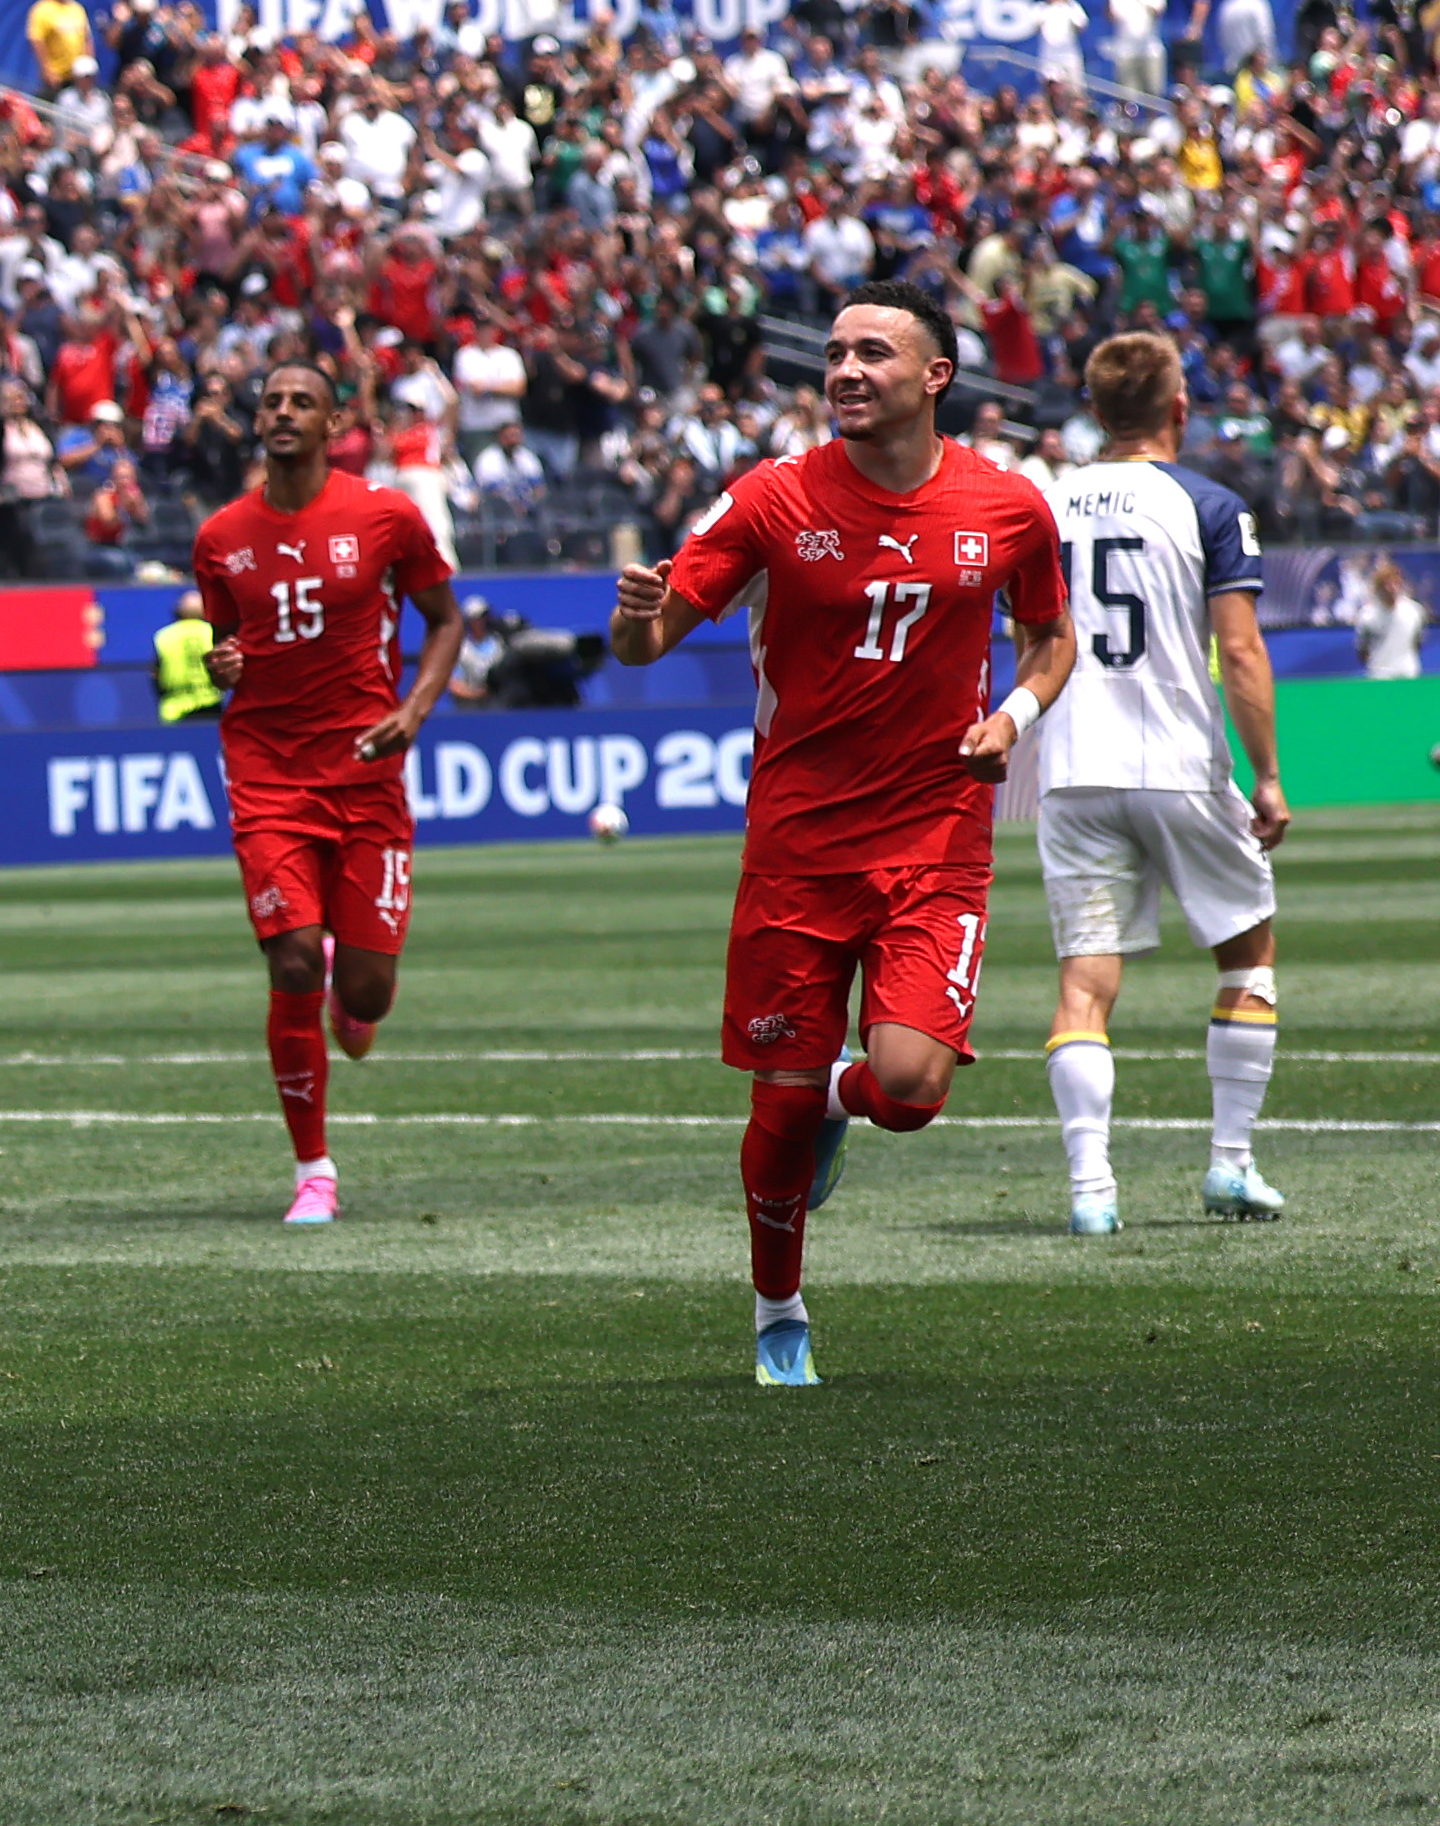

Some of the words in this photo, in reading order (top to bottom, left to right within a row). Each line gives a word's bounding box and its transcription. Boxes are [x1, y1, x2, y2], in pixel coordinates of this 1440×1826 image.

[269, 576, 324, 643] 15
[854, 581, 933, 663] 17
[47, 753, 215, 836] FIFA
[500, 735, 650, 815] CUP
[652, 730, 754, 808] 20
[375, 847, 411, 912] 15
[945, 913, 985, 989] 1
